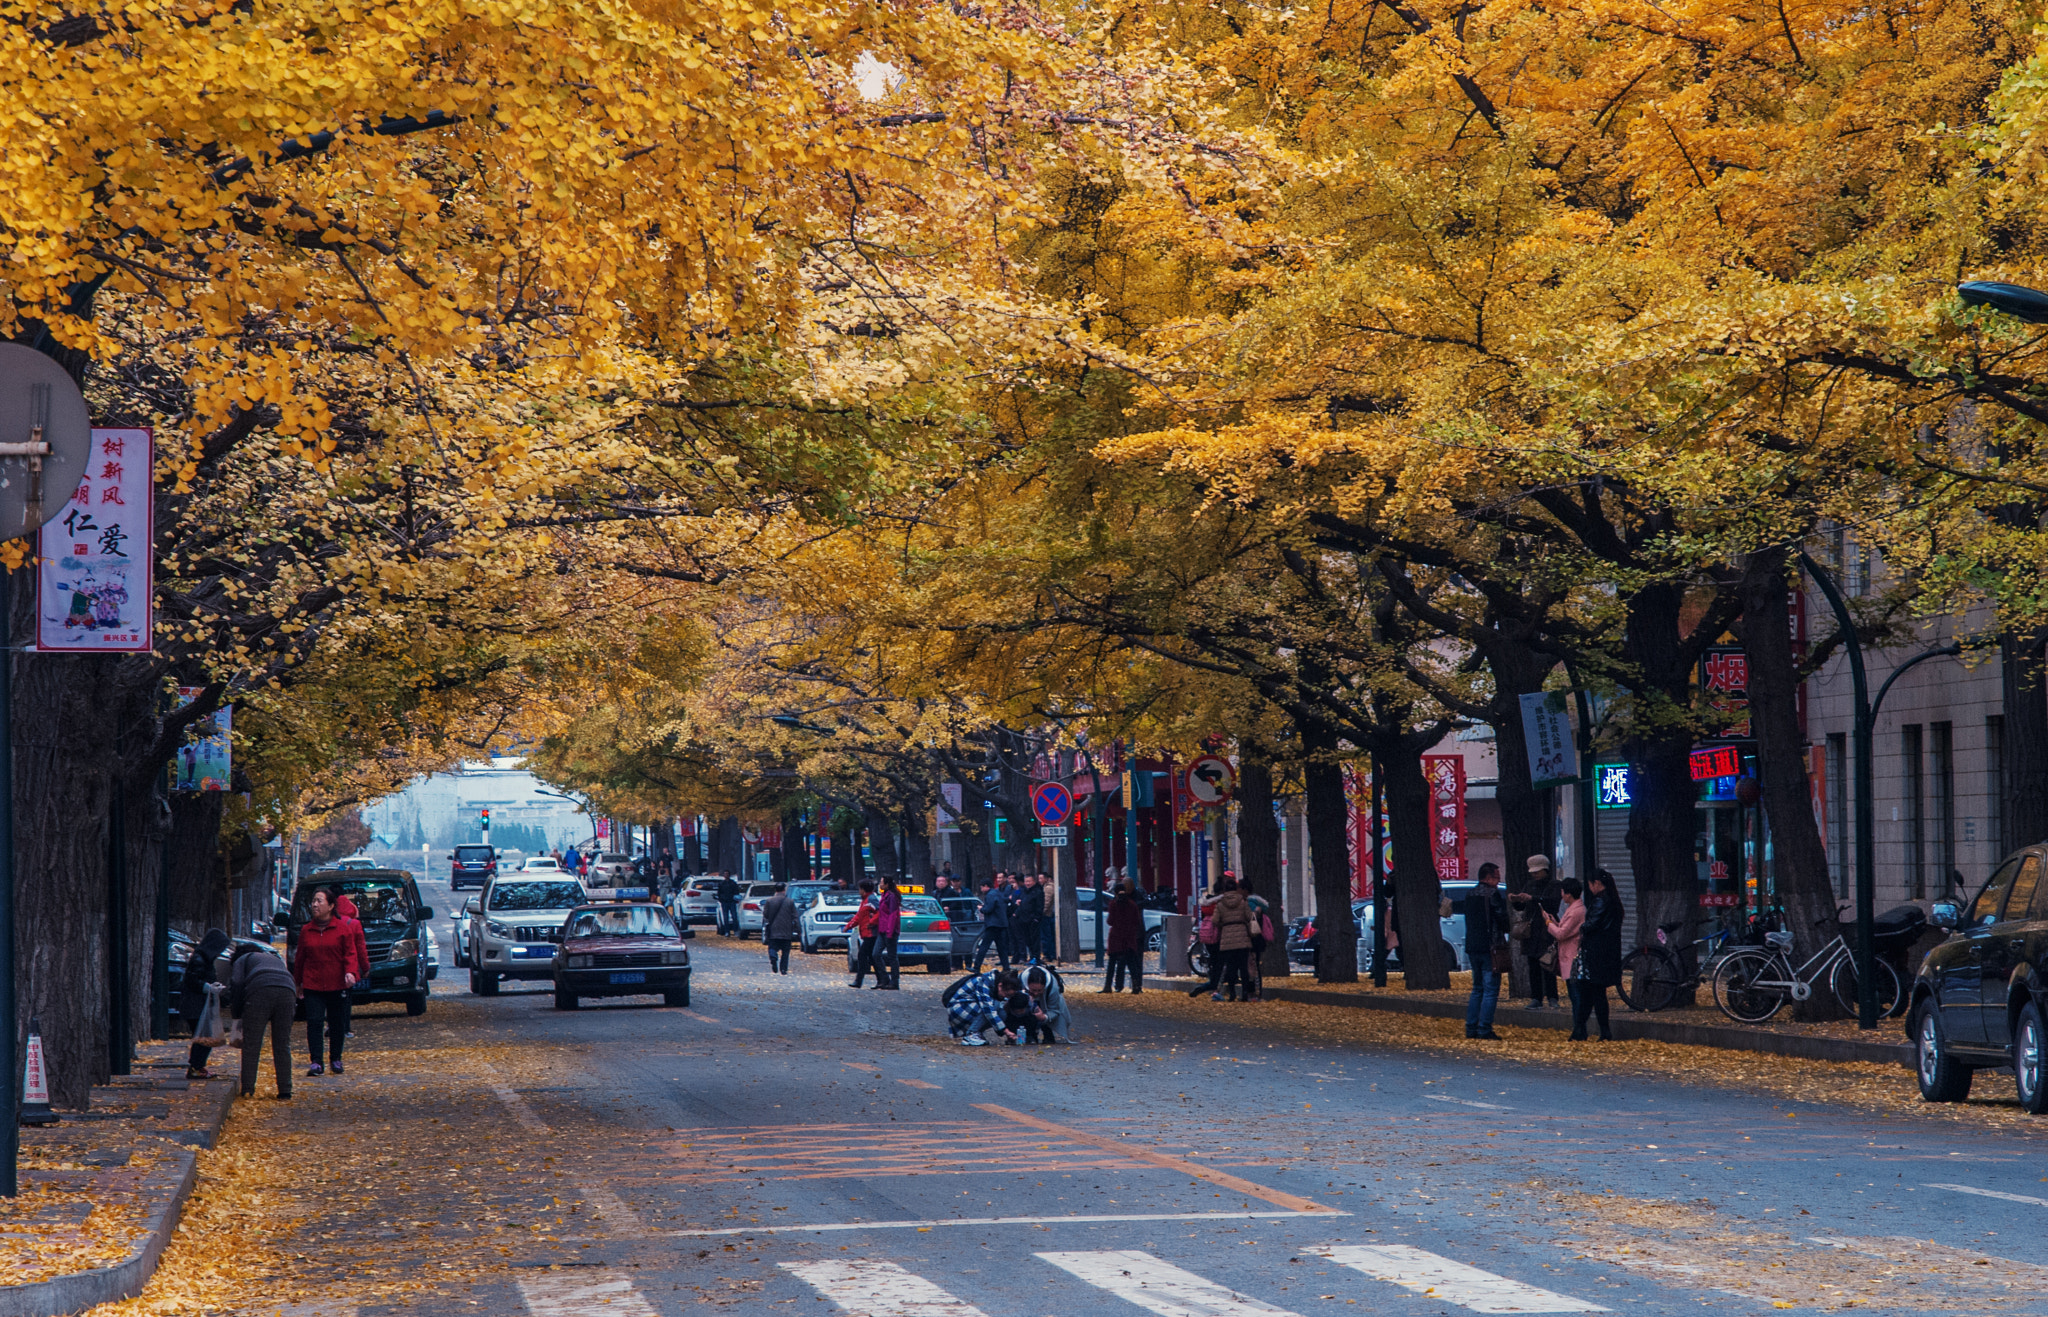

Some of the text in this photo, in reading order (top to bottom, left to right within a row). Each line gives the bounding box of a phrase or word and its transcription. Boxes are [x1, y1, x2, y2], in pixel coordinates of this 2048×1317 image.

[100, 437, 126, 506] 树新风
[63, 508, 128, 558] 仁爱
[103, 634, 128, 642] 振兴区
[1439, 772, 1458, 847] 高丽街
[1439, 857, 1459, 868] 고려
[1439, 868, 1459, 878] 거리
